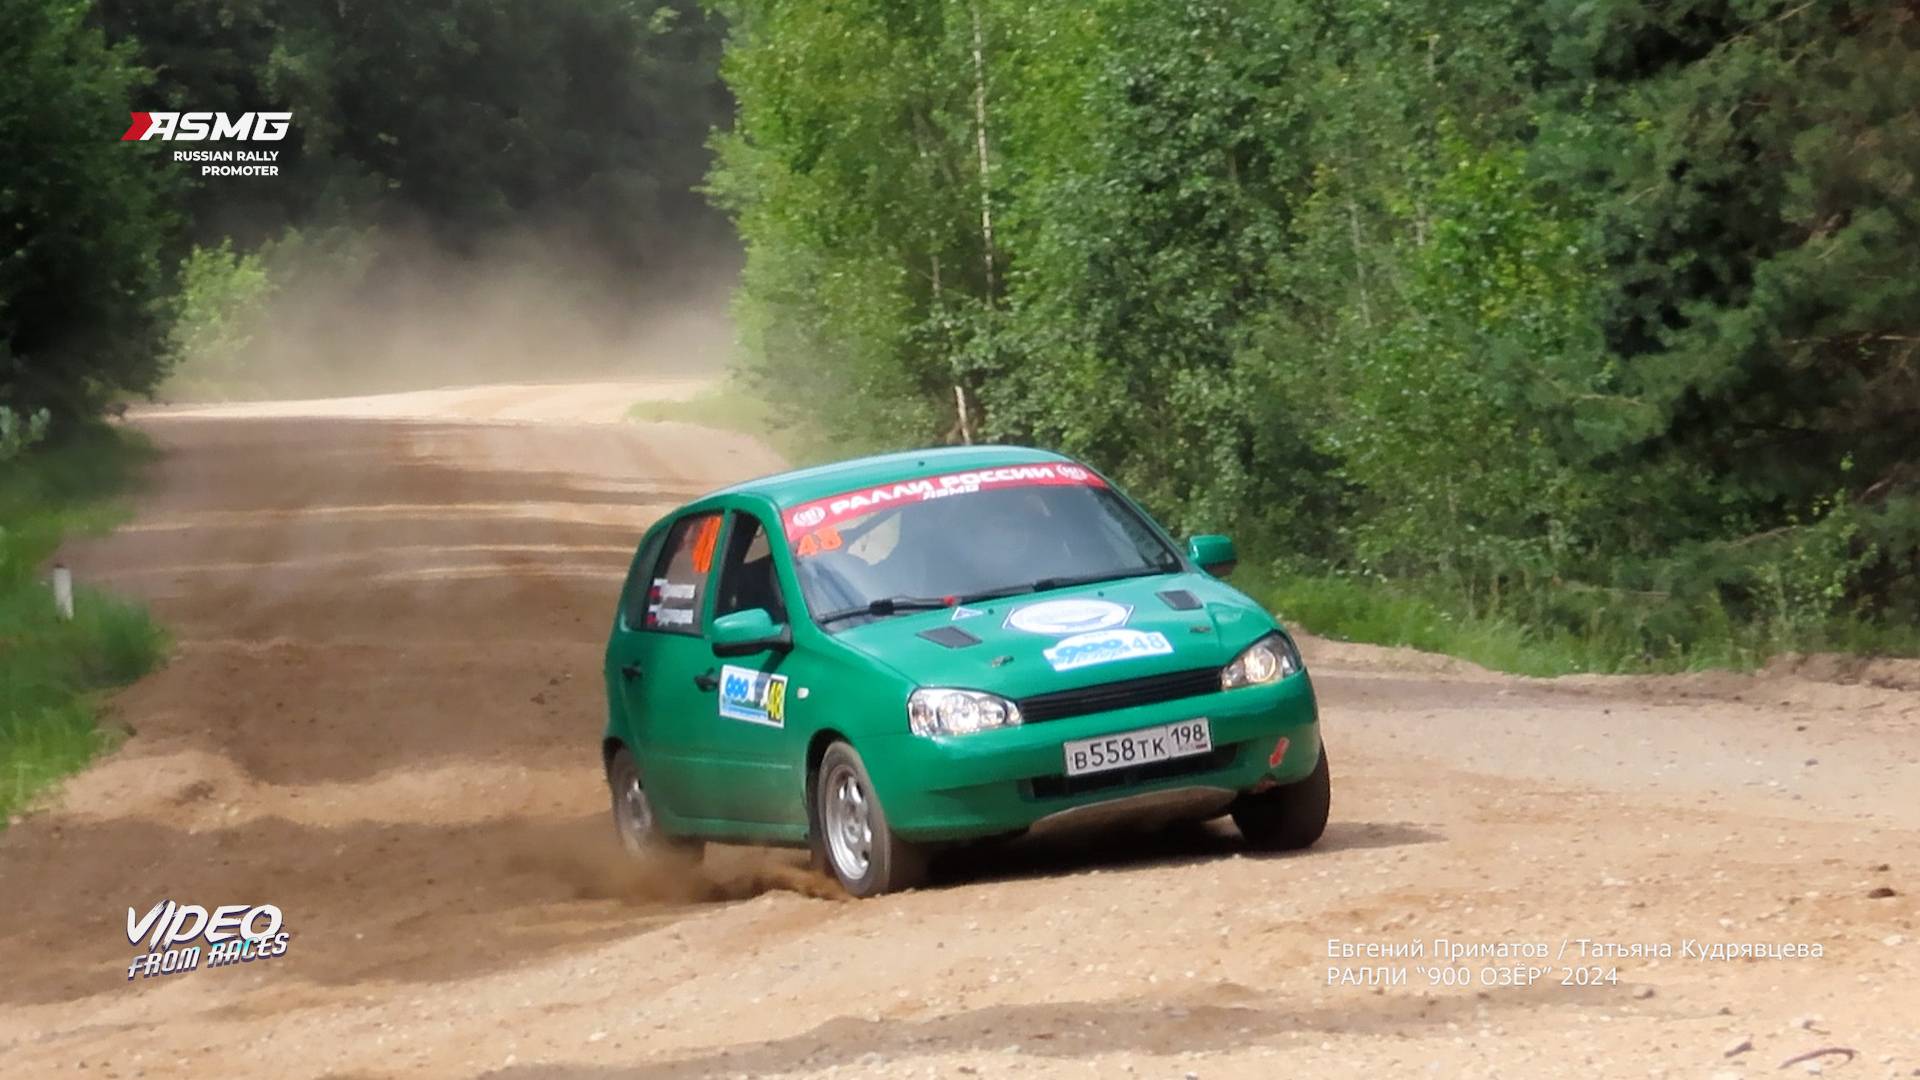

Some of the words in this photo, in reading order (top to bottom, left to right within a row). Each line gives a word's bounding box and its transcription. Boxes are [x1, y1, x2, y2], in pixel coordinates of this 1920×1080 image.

[829, 479, 932, 515] РАЛЛИ
[939, 466, 1055, 489] РОССИИ
[1132, 634, 1165, 650] 48
[1170, 723, 1204, 746] 198
